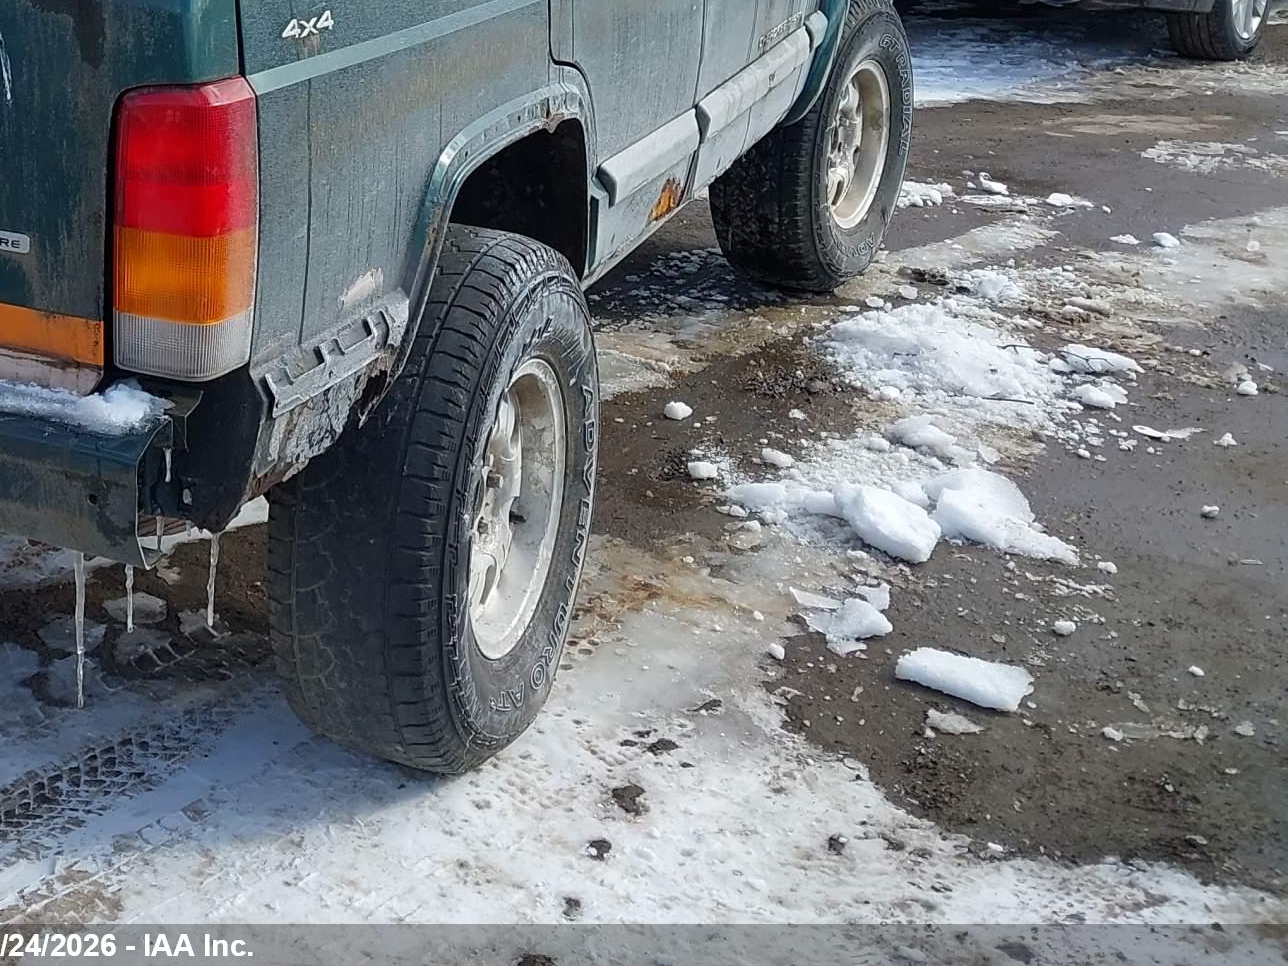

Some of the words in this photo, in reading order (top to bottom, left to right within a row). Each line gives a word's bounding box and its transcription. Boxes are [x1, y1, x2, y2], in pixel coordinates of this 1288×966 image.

[281, 9, 334, 38] 4x4
[879, 34, 901, 52] GT
[895, 51, 913, 156] RADIAL
[530, 384, 596, 690] ADVENTURO
